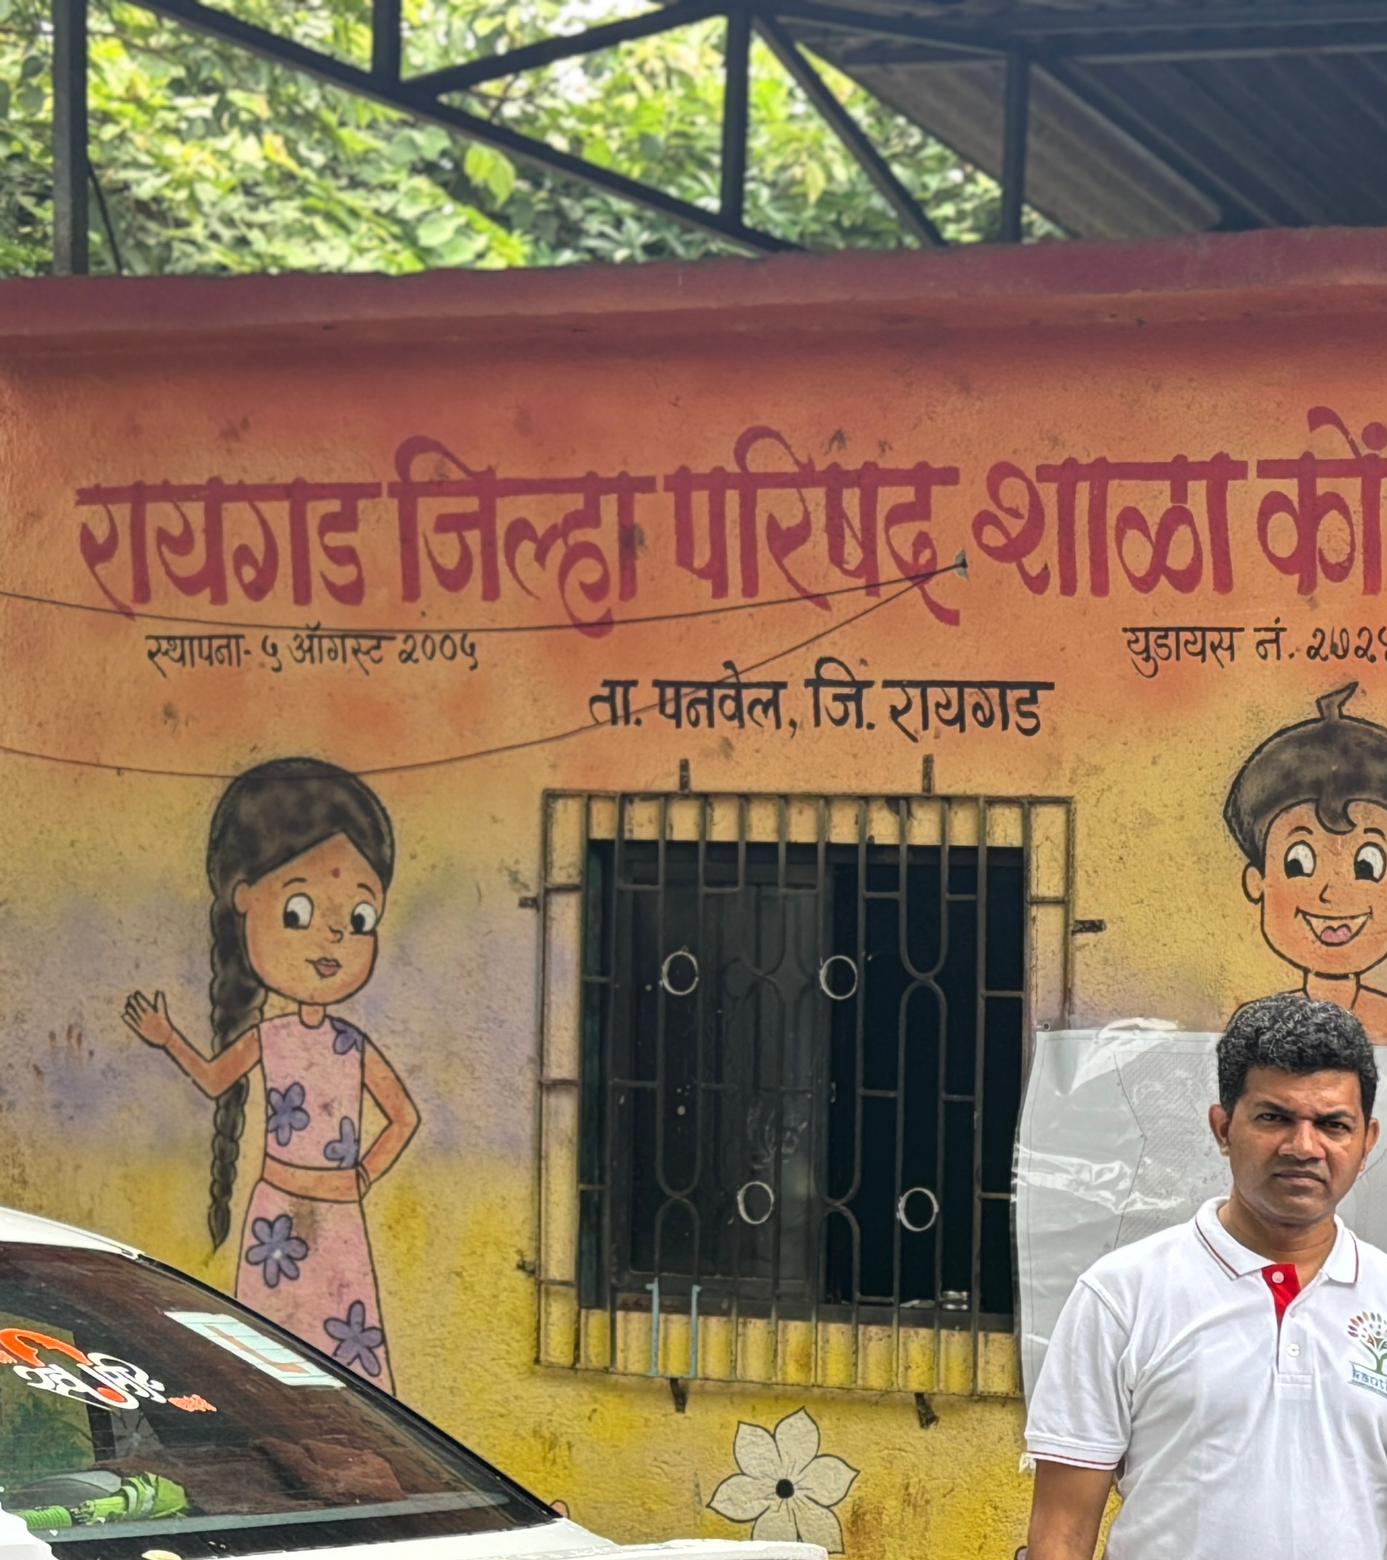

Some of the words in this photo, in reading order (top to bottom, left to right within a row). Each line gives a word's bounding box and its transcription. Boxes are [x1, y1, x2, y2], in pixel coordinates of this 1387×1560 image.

[75, 476, 383, 621] रायगड
[387, 435, 657, 638] जिल्हा
[971, 453, 1249, 598] शाळा
[288, 620, 397, 676] ऑगस्ट
[398, 633, 479, 672] २००५
[1122, 626, 1245, 679] युडायस
[588, 679, 643, 727] ता.
[804, 656, 876, 731] जि.
[882, 681, 1056, 743] रायगड
